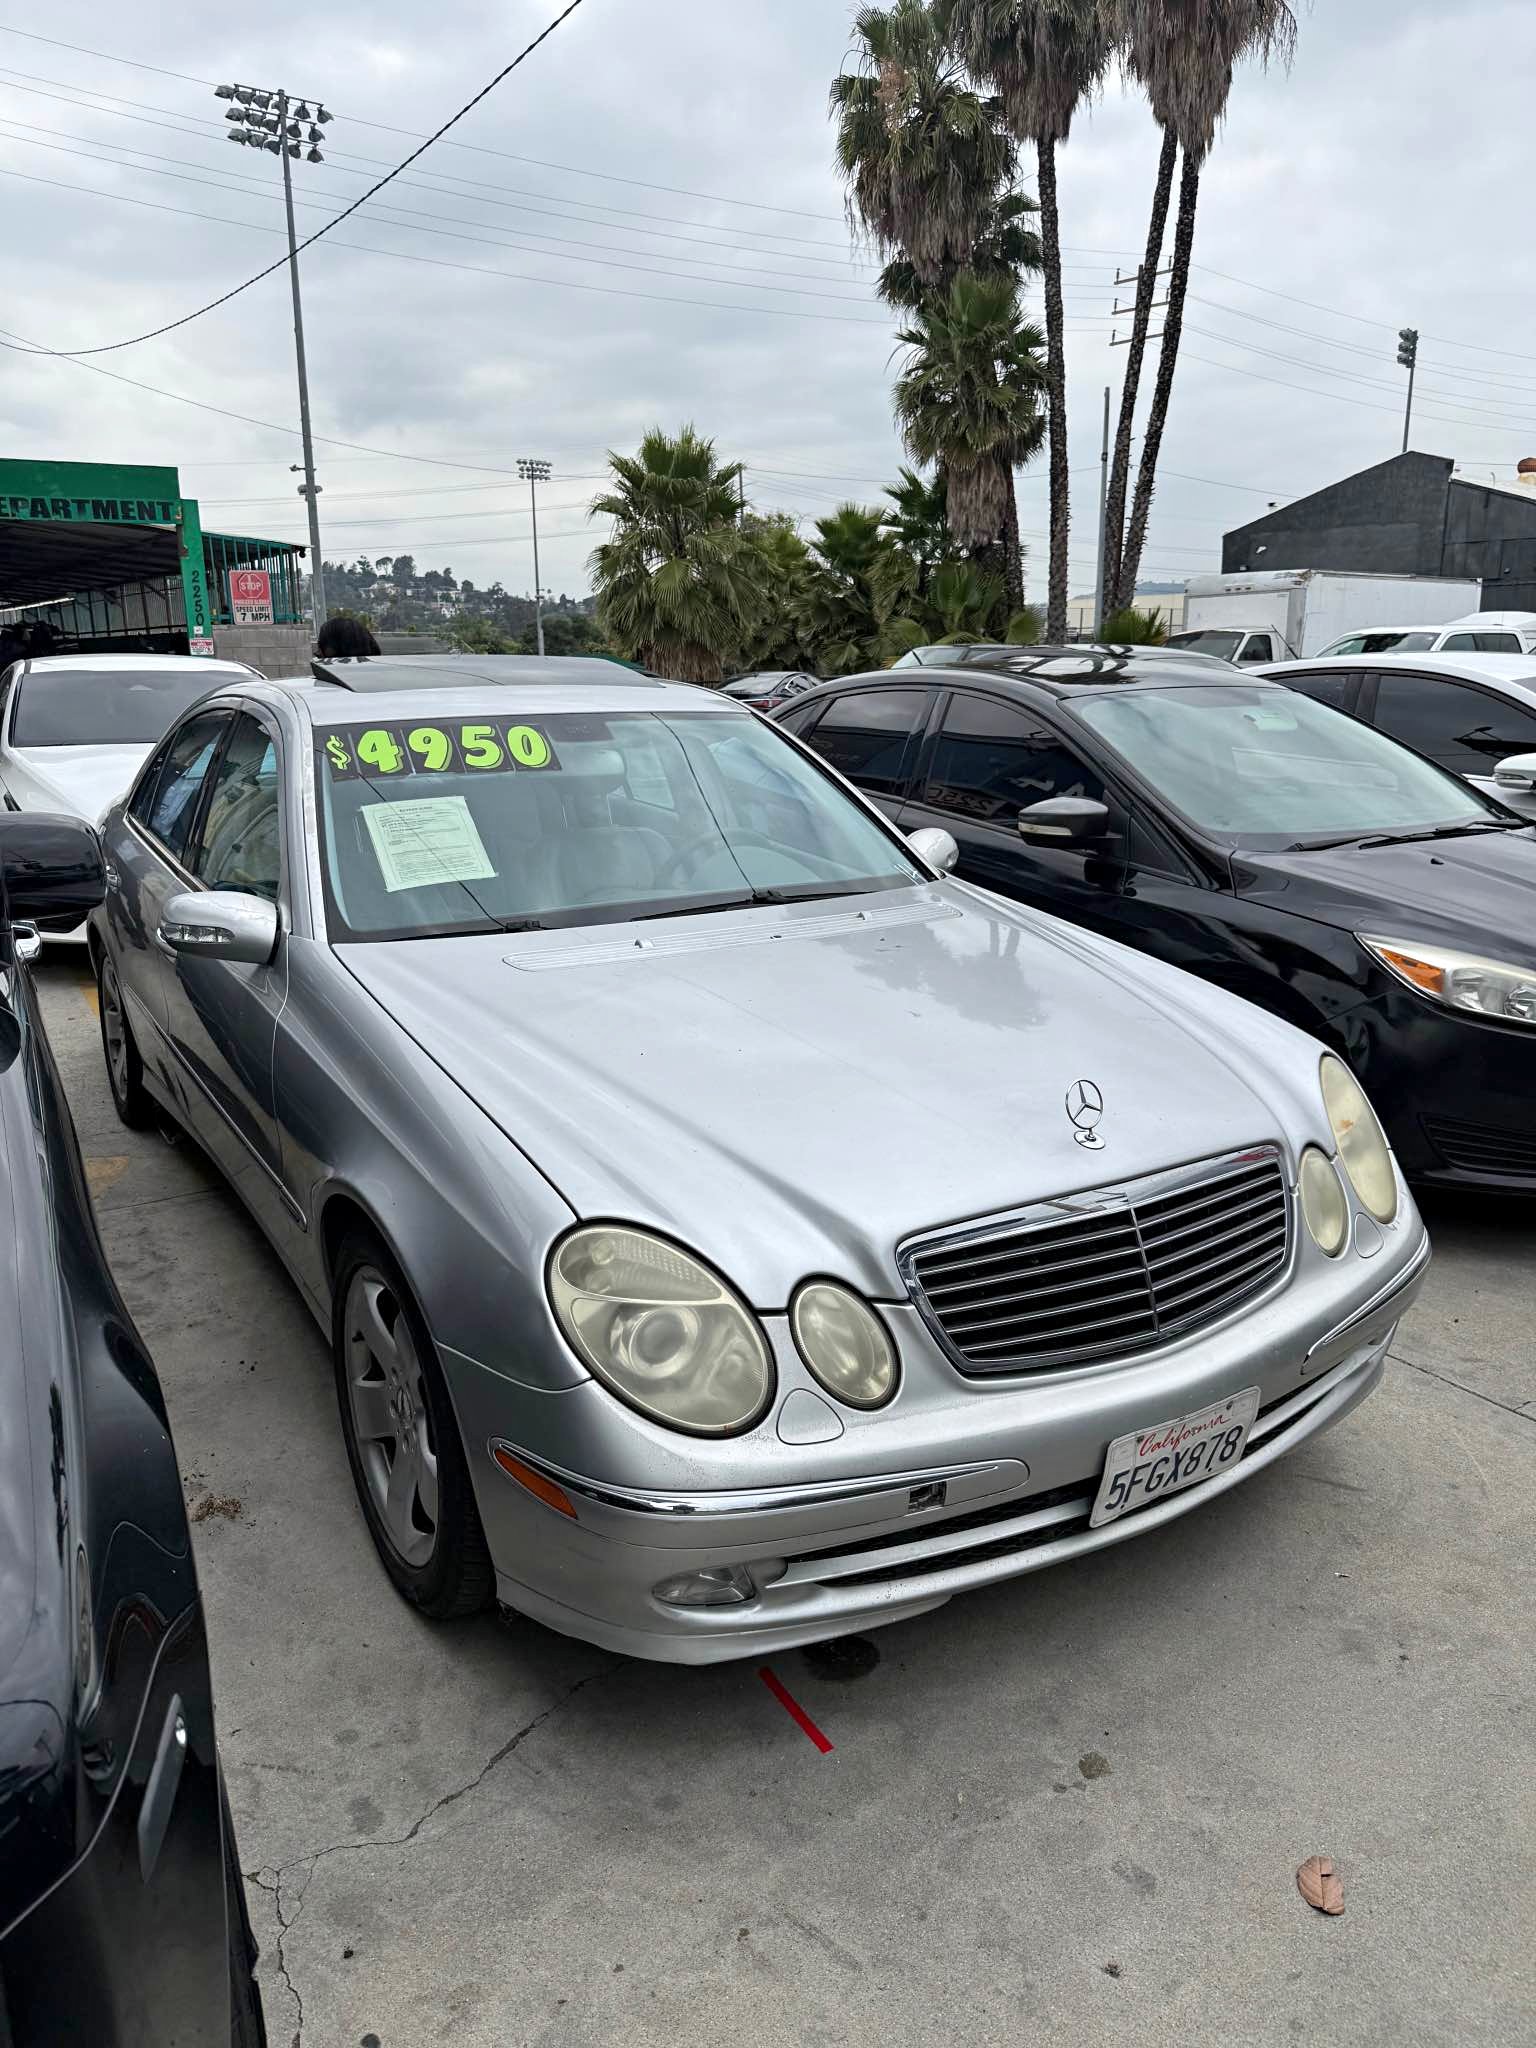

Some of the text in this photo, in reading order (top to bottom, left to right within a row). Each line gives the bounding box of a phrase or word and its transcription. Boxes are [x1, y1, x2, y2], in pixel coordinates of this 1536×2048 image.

[192, 569, 205, 626] 2250
[240, 582, 262, 591] STOP
[241, 612, 271, 622] 7 MPH
[1139, 1414, 1231, 1457] California
[1105, 1424, 1244, 1510] 5FGX878
